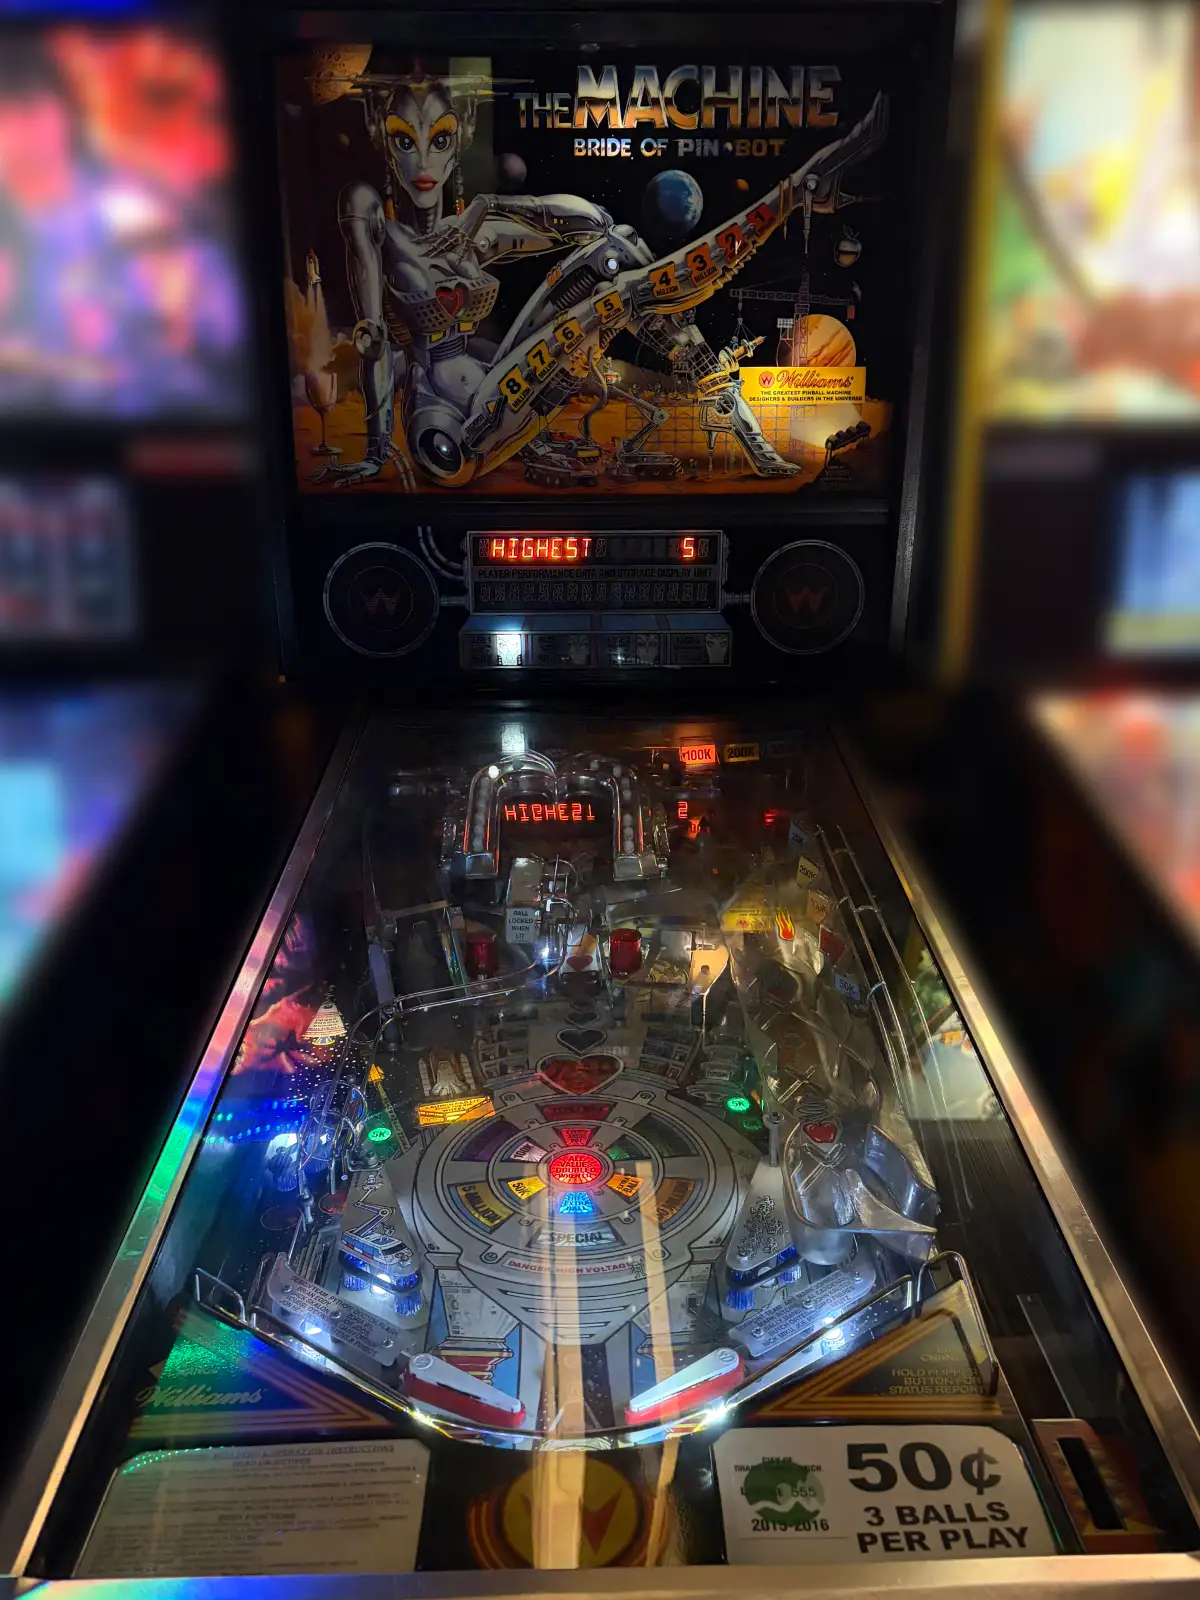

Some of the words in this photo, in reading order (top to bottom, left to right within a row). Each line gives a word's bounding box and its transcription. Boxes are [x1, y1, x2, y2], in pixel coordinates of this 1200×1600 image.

[513, 92, 574, 129] THE
[572, 64, 843, 130] MACHINE
[574, 138, 632, 157] BRIDE
[640, 138, 669, 157] OF
[692, 253, 707, 272] 3
[658, 270, 672, 286] 4
[694, 265, 718, 283] MILLION
[656, 285, 679, 297] MILLION
[604, 298, 615, 312] 5
[604, 307, 622, 320] MILLION
[562, 326, 575, 341] 6
[566, 333, 585, 351] MILLION
[532, 350, 546, 366] 7
[538, 359, 558, 380] MILLION
[506, 377, 521, 394] 8
[776, 370, 854, 389] Williams
[512, 386, 533, 408] MILLION
[492, 538, 592, 558] HIGHEST
[478, 568, 510, 579] PLAYER
[511, 568, 575, 579] PERFORMANCE
[575, 568, 598, 579] DATA
[600, 567, 616, 578] AND
[618, 567, 656, 578] STORAGE
[657, 567, 691, 578] DISPLAY
[693, 567, 712, 578] UNIT
[686, 748, 712, 760] 100K
[727, 746, 755, 759] 200K
[799, 865, 817, 879] 200K
[839, 979, 856, 996] 50K
[514, 1143, 533, 1160] 100K
[512, 1182, 531, 1196] 50K
[623, 1180, 640, 1197] BALL
[465, 1192, 502, 1224] MILLION
[549, 1231, 605, 1243] SPECIAL
[767, 1321, 790, 1336] BUTCH
[892, 1369, 925, 1377] HOLD
[904, 1377, 953, 1386] BUTTON
[136, 1383, 264, 1409] Williams
[889, 1385, 933, 1395] STATUS
[935, 1385, 984, 1395] REPORT
[846, 1441, 1002, 1496] 50¢
[865, 1506, 886, 1527] 3
[895, 1501, 1010, 1527] BALLS
[751, 1518, 830, 1532] 2015-2016
[857, 1531, 928, 1554] PER
[942, 1526, 1029, 1551] PLAY
